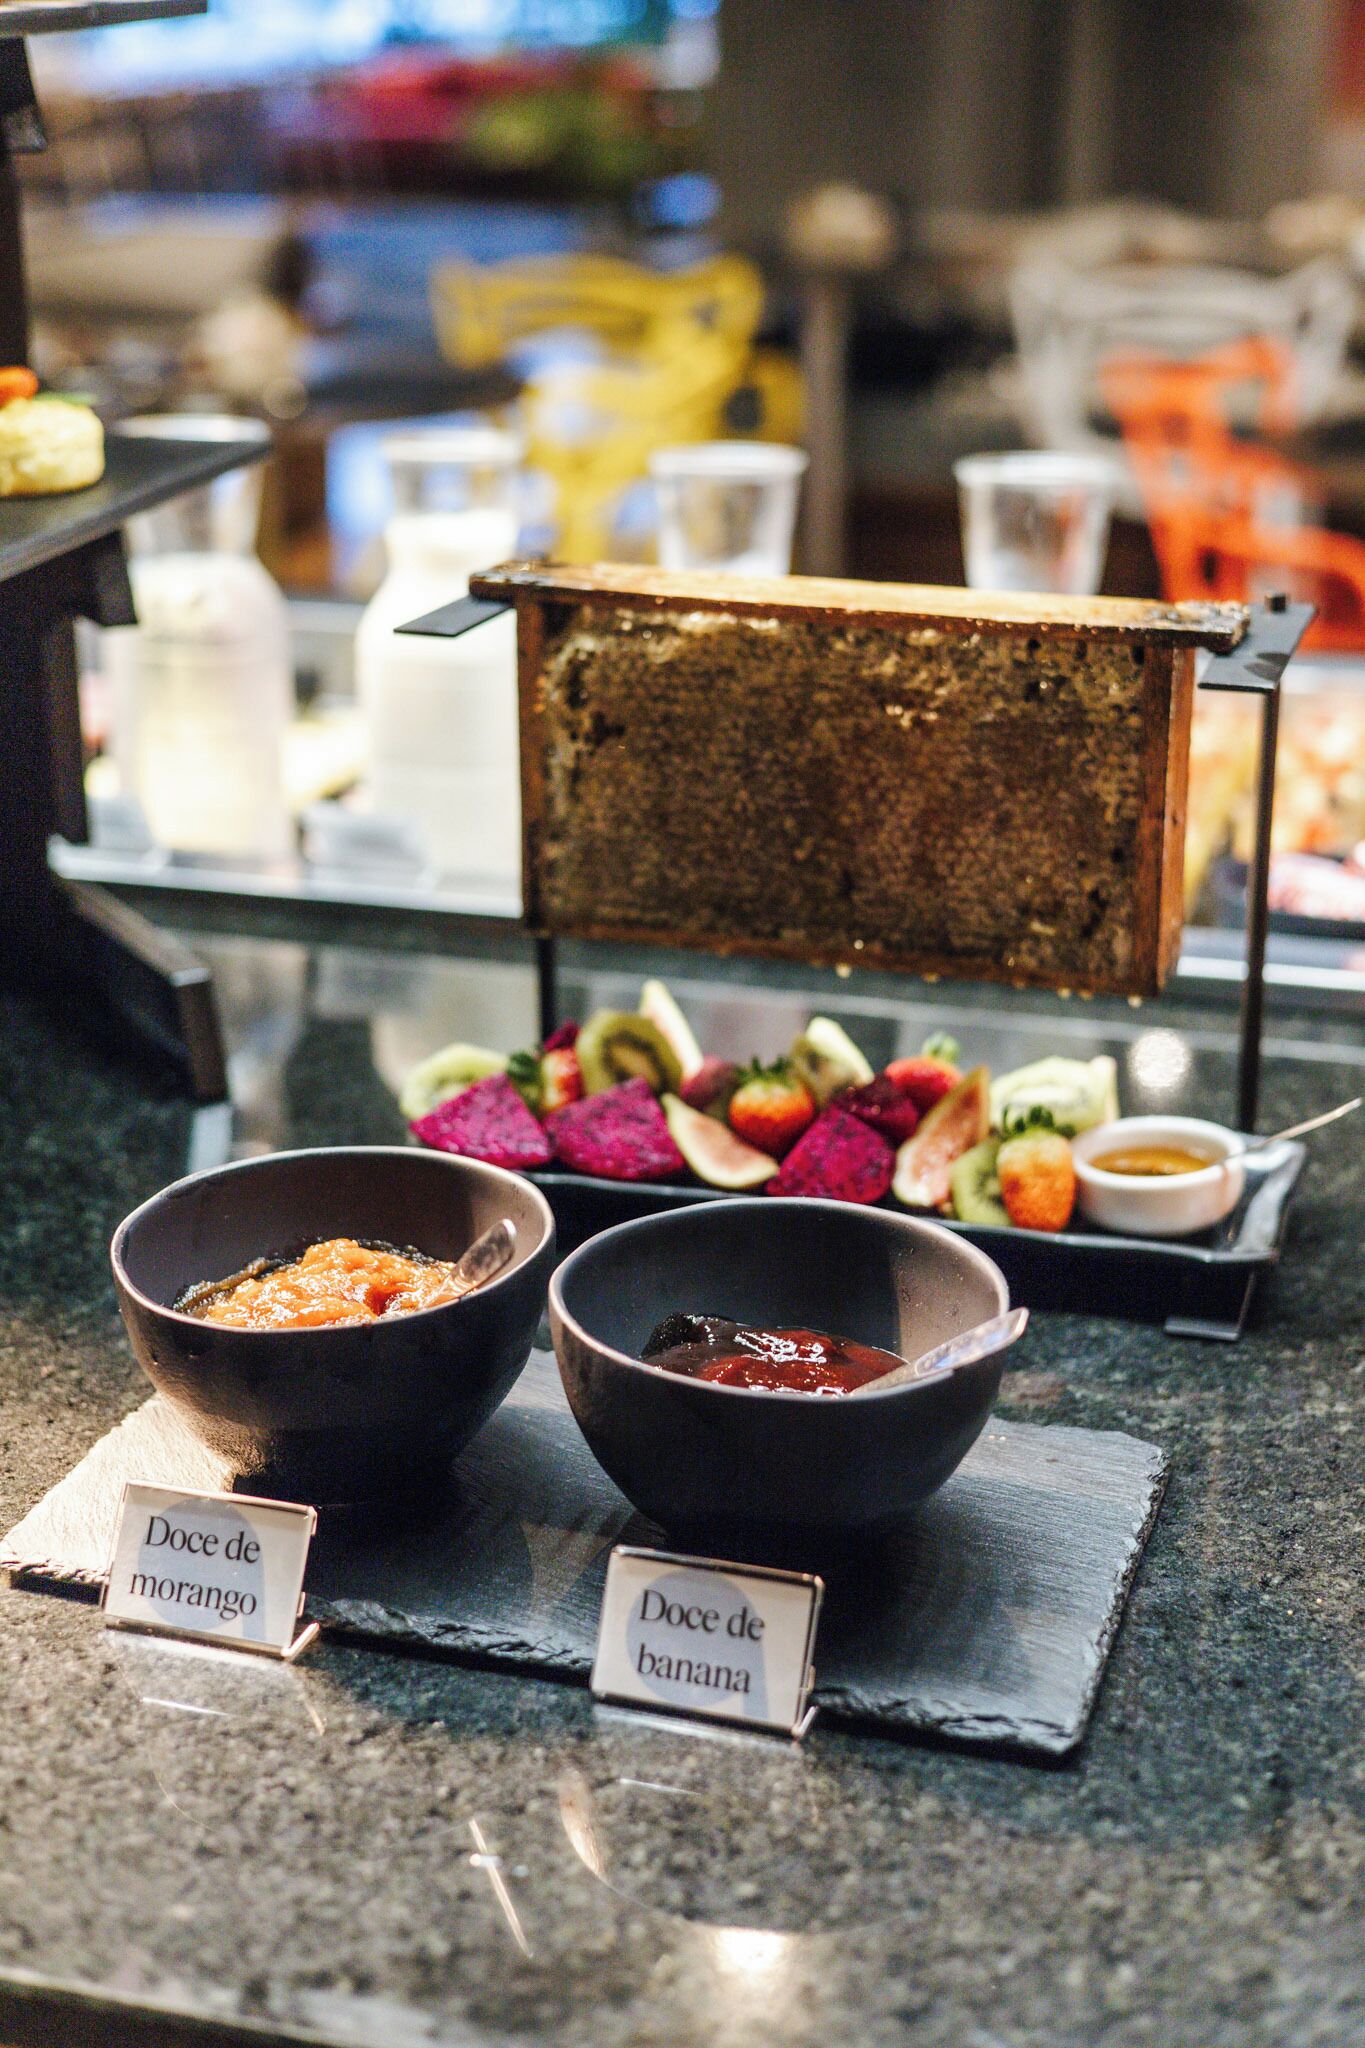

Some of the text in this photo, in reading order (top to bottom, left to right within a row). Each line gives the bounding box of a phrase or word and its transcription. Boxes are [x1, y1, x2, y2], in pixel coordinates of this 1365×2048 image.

[145, 1516, 261, 1564] Doce de
[129, 1573, 257, 1620] morango
[639, 1588, 765, 1641] Doce de
[636, 1642, 750, 1693] banana
